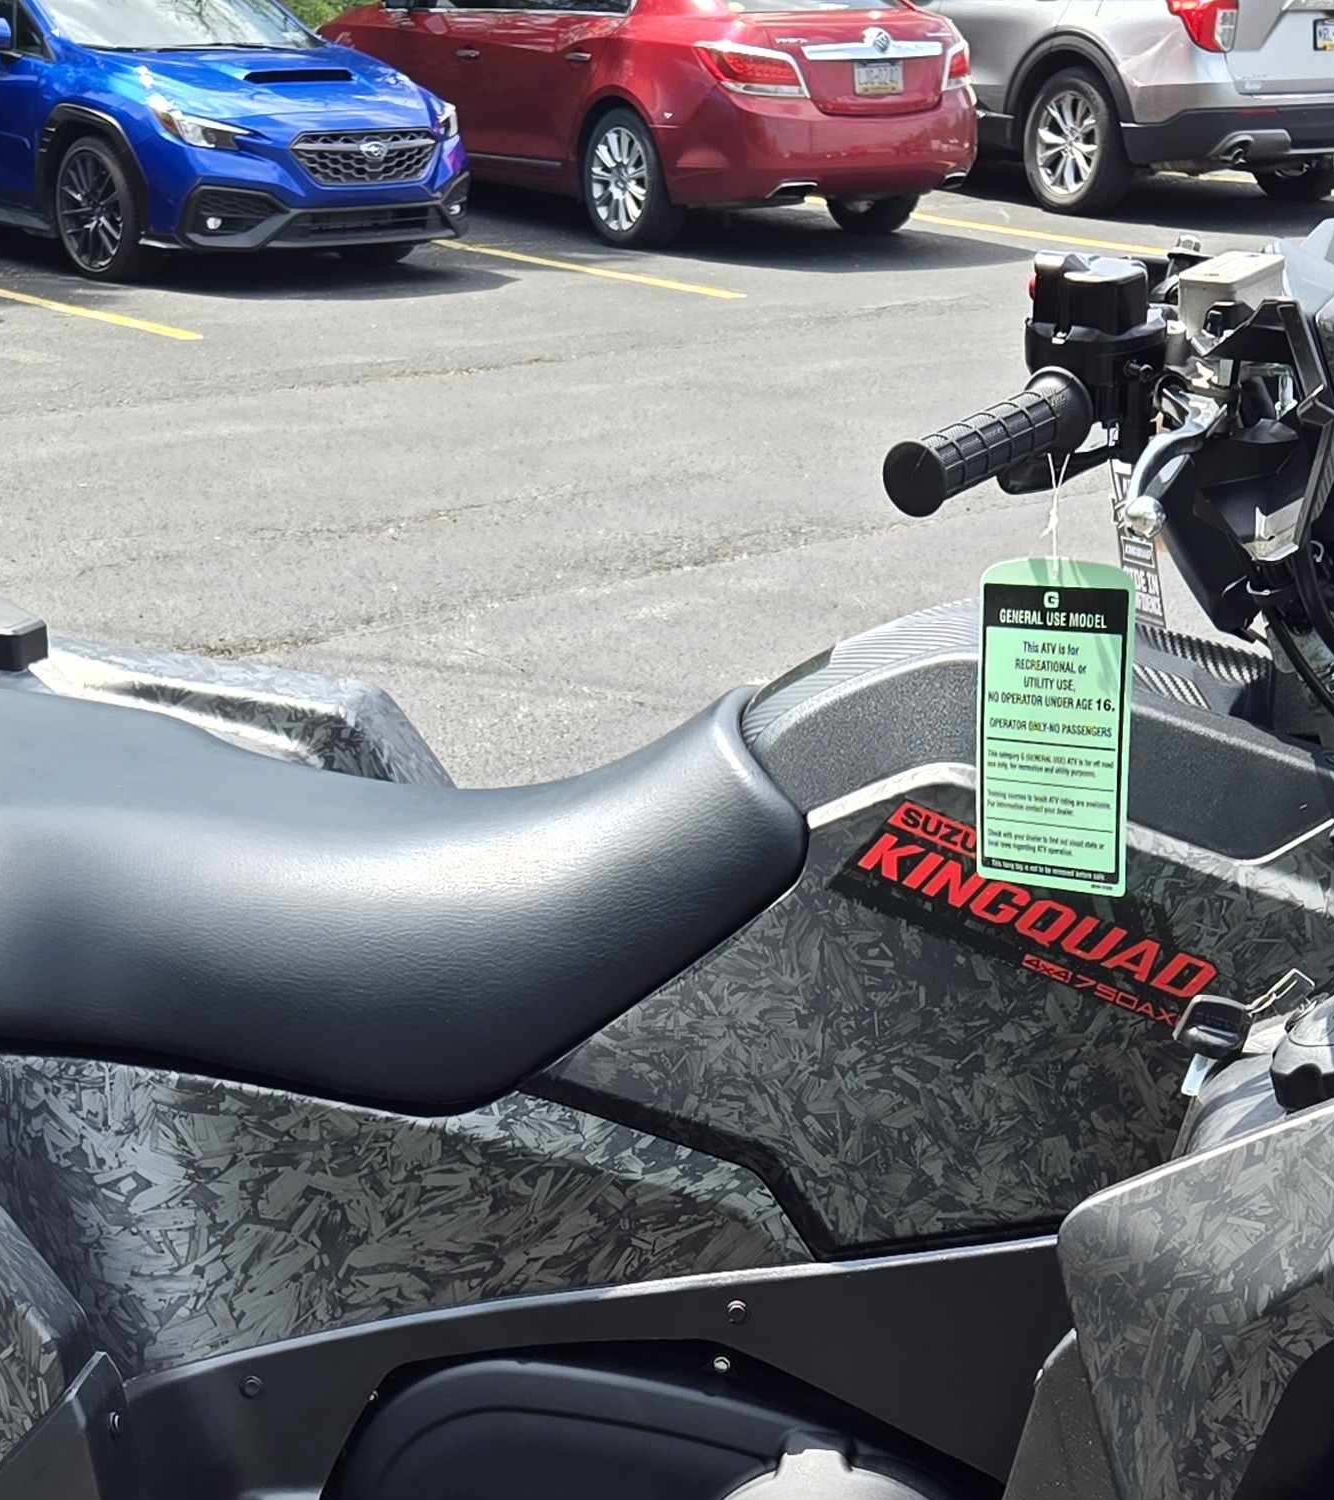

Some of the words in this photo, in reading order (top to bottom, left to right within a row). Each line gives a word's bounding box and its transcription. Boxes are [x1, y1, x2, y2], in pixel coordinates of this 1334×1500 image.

[999, 608, 1043, 625] GENERAL
[1046, 612, 1067, 626] USE
[1069, 613, 1107, 629] MODEL
[1023, 641, 1039, 654] This
[1041, 642, 1057, 655] ATV
[1058, 643, 1065, 655] is
[1067, 643, 1080, 656] for
[1015, 658, 1076, 674] RECREATIONAL
[1078, 665, 1087, 674] or
[1024, 676, 1055, 688] UTILITY
[1056, 679, 1076, 693] USE,
[988, 691, 999, 702] NO
[1001, 692, 1043, 707] OPERATOR
[1045, 697, 1073, 709] UNDER
[1075, 698, 1093, 710] AGE
[1096, 698, 1115, 712] 16.
[989, 717, 1026, 730] OPERATOR
[1062, 723, 1112, 738] PASSENGERS
[901, 807, 976, 853] SUZU
[858, 832, 1219, 999] KINGQUAD
[1024, 959, 1070, 981] 4x4
[1075, 974, 1181, 1027] 750AX
